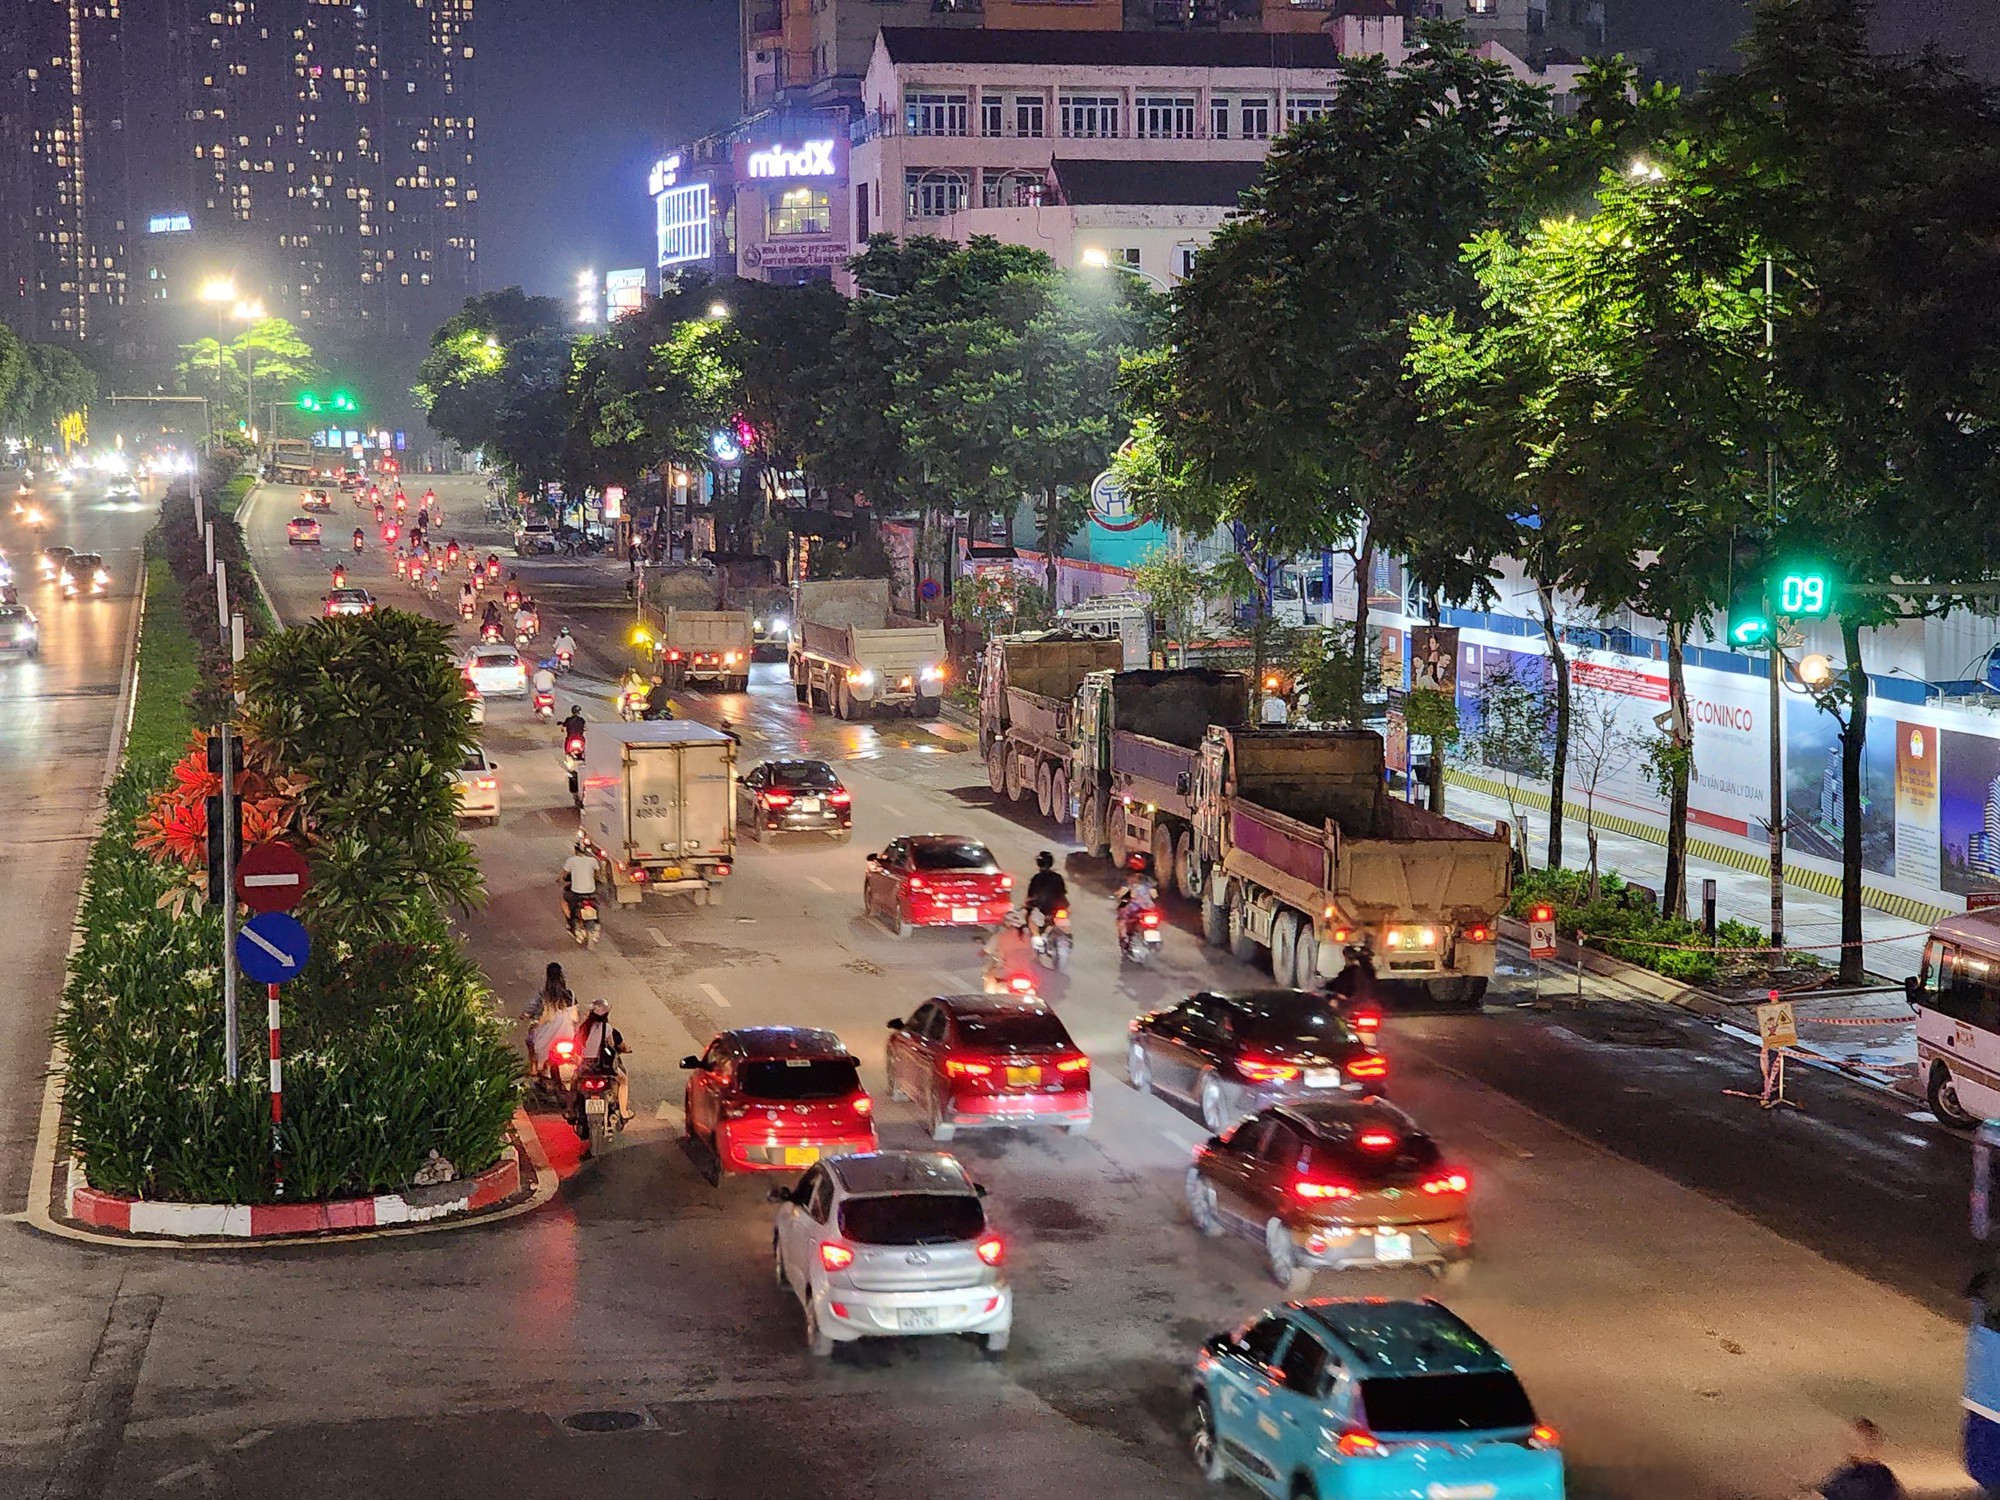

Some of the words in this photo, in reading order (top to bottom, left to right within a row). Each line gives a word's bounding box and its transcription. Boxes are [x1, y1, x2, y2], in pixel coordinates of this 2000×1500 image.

[749, 140, 836, 178] mindX
[1782, 576, 1825, 612] 09
[1696, 701, 1752, 731] CONINCO
